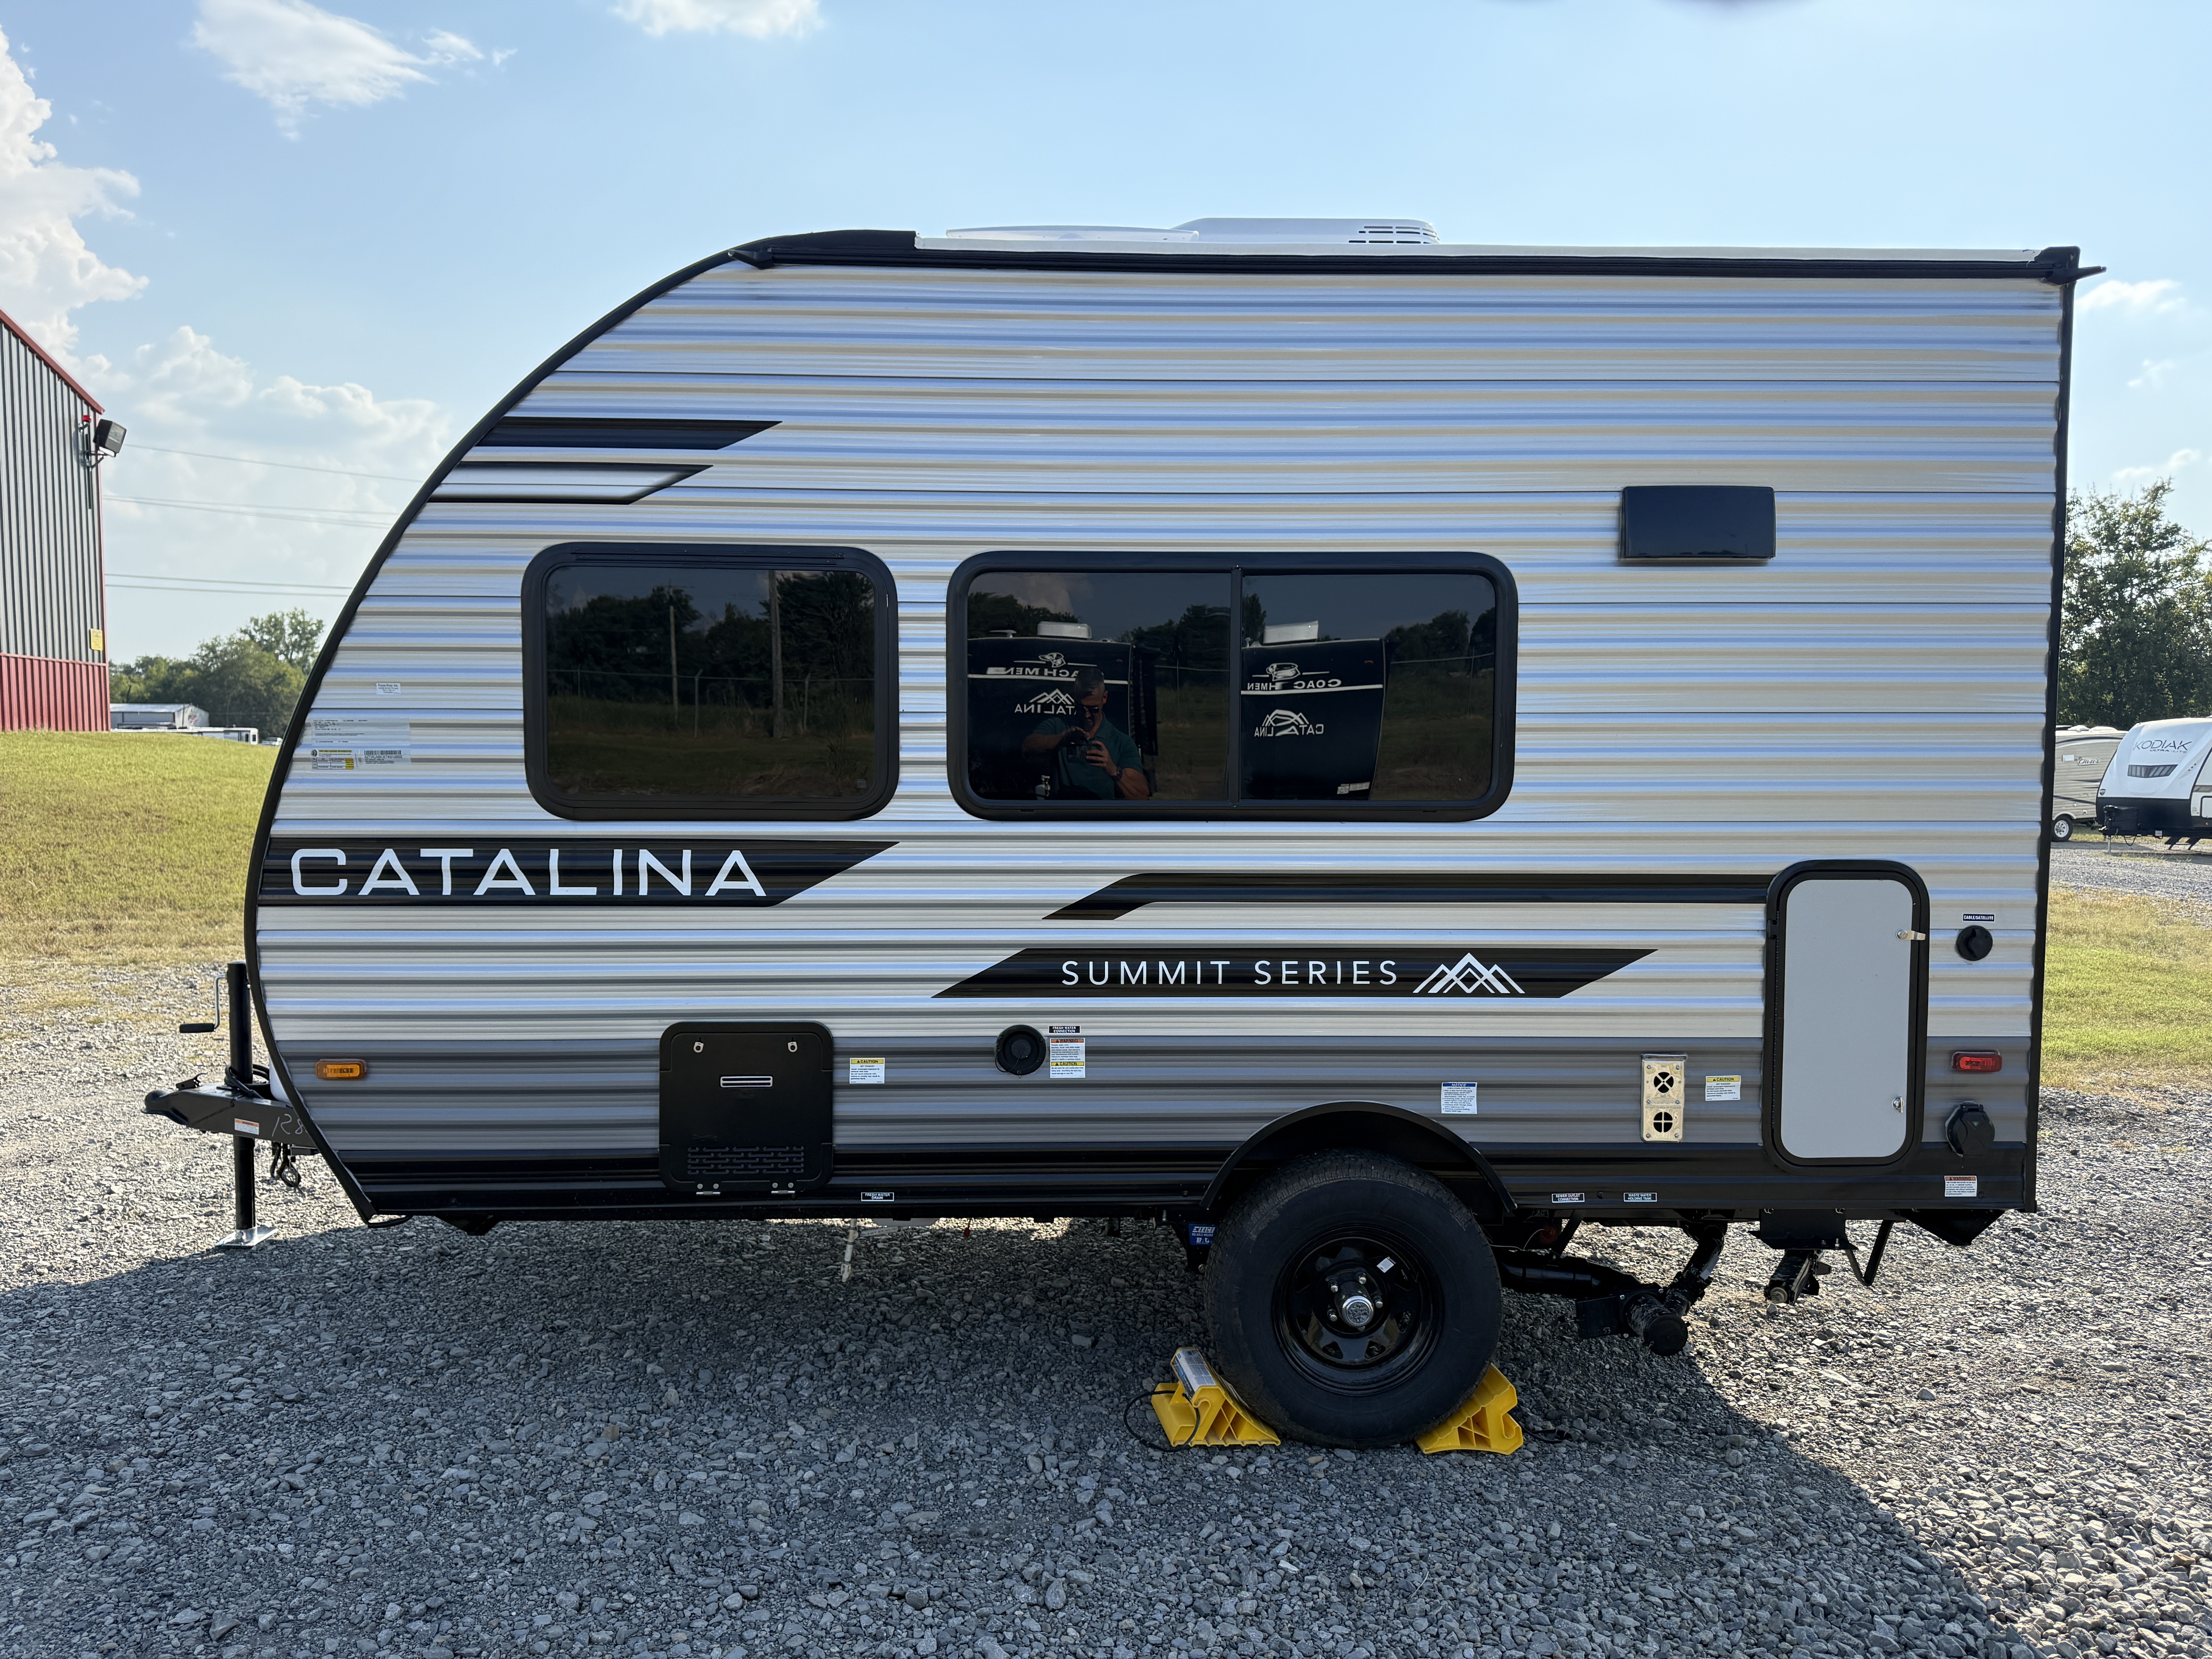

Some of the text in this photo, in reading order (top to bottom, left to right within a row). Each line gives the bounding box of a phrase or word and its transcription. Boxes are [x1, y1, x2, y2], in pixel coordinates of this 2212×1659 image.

[2133, 740, 2192, 750] KODIAK
[291, 848, 767, 897] CATALINA
[1061, 960, 1397, 986] SUMMIT SERIES
